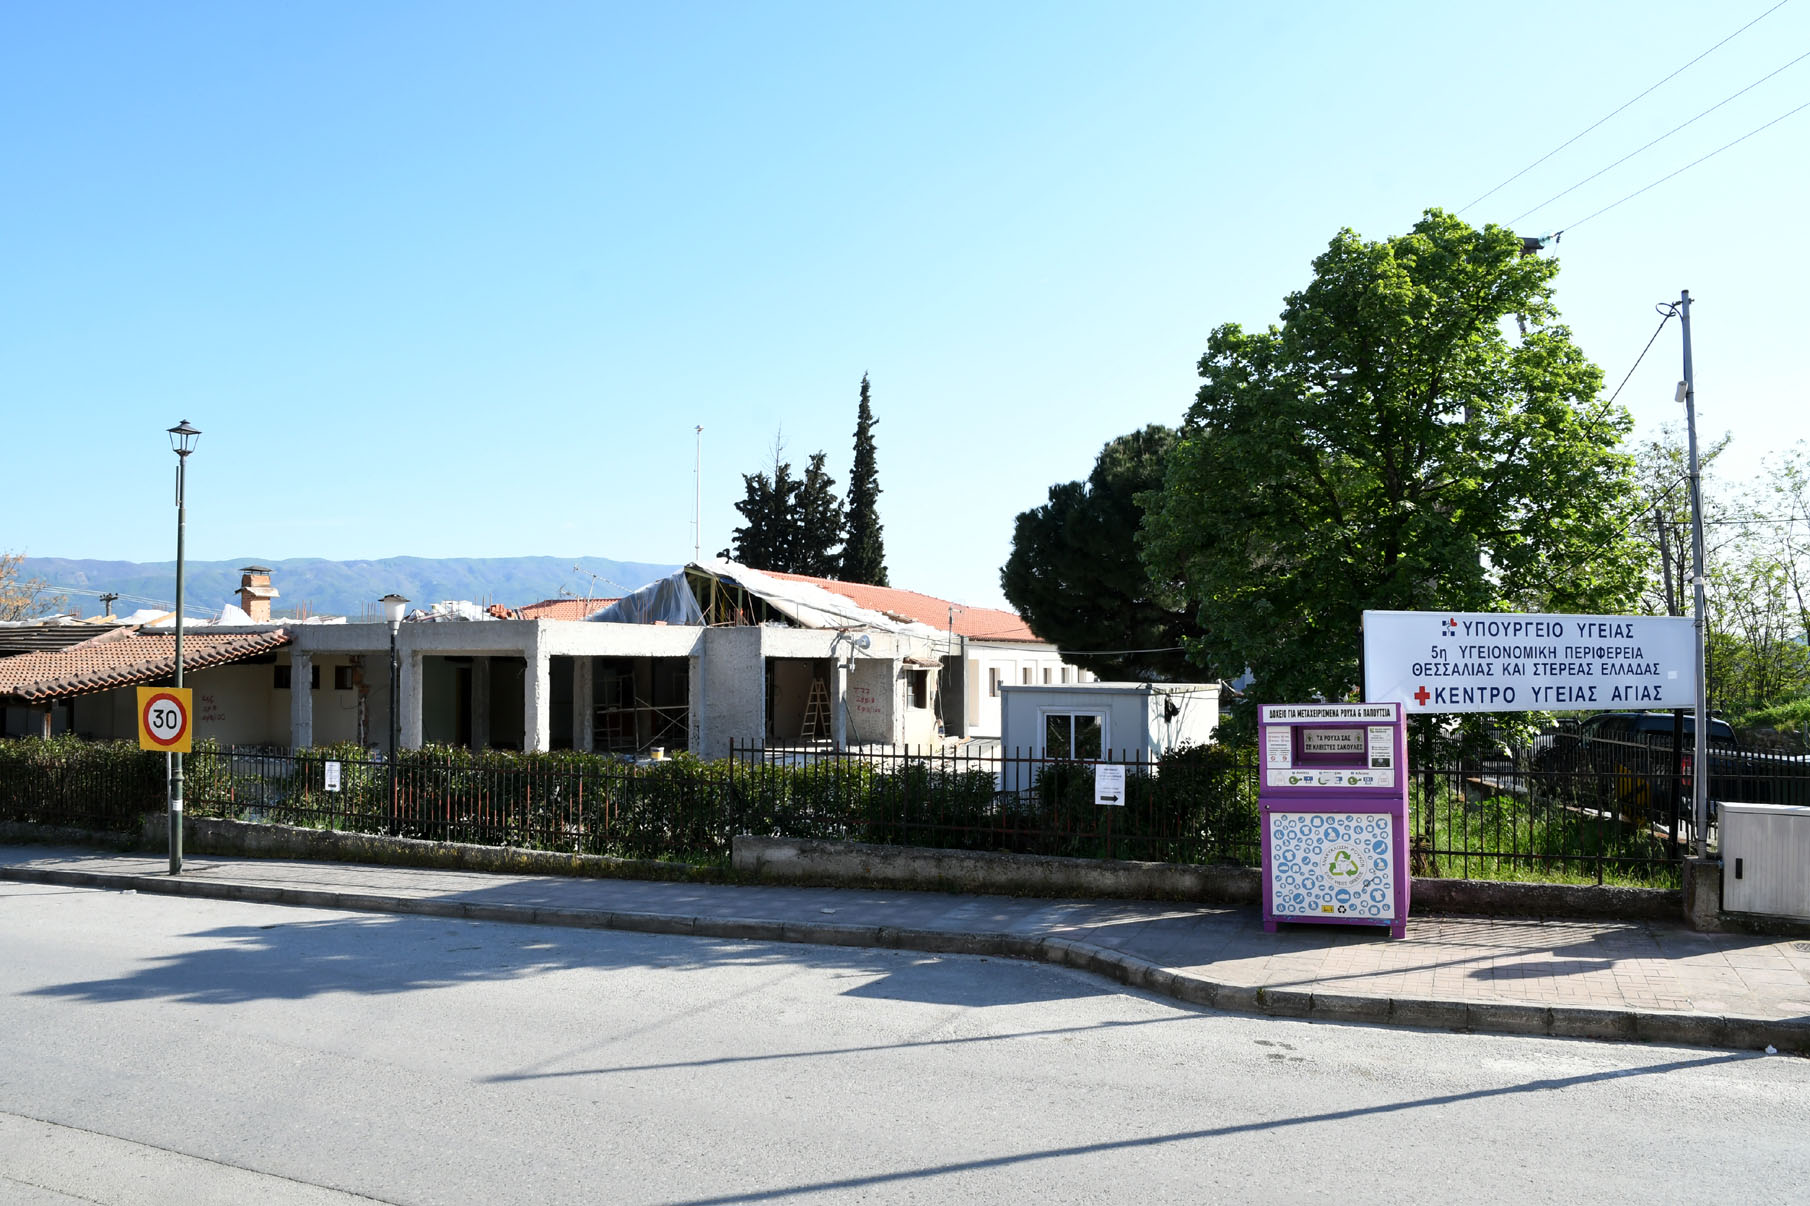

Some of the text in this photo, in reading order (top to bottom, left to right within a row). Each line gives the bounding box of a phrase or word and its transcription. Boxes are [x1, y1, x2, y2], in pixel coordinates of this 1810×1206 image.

[1462, 620, 1634, 639] ΥΠΟΥΡΓΕΙΟ ΥΓΕΙΑΣ
[1431, 645, 1644, 662] 5η ΥΓΕΙΟΝΟΜΙΚΗ ΠΕΡΙΦΕΡΕΙΑ
[1412, 662, 1661, 677] ΘΕΣΣΑΛΙΑΣ ΚΑΙ ΣΤΕΡΕΑΣ ΕΛΛΑΔΑΣ
[1435, 685, 1663, 705] ΚΕΝΤΡΟ ΥΓΕΙΑΣ ΑΓΙΑΣ
[153, 709, 177, 729] 30
[1269, 709, 1287, 719] ΔΟΧΕΙΟ
[1288, 709, 1296, 719] ΓΙΑ
[1297, 709, 1339, 718] ΜΕΤΑΧΕΙΡΙΣΜΕΝΑ
[1340, 708, 1357, 718] ΡΟΥΧΑ
[1363, 708, 1391, 717] ΠΑΠΟΥΤΣΙΑ
